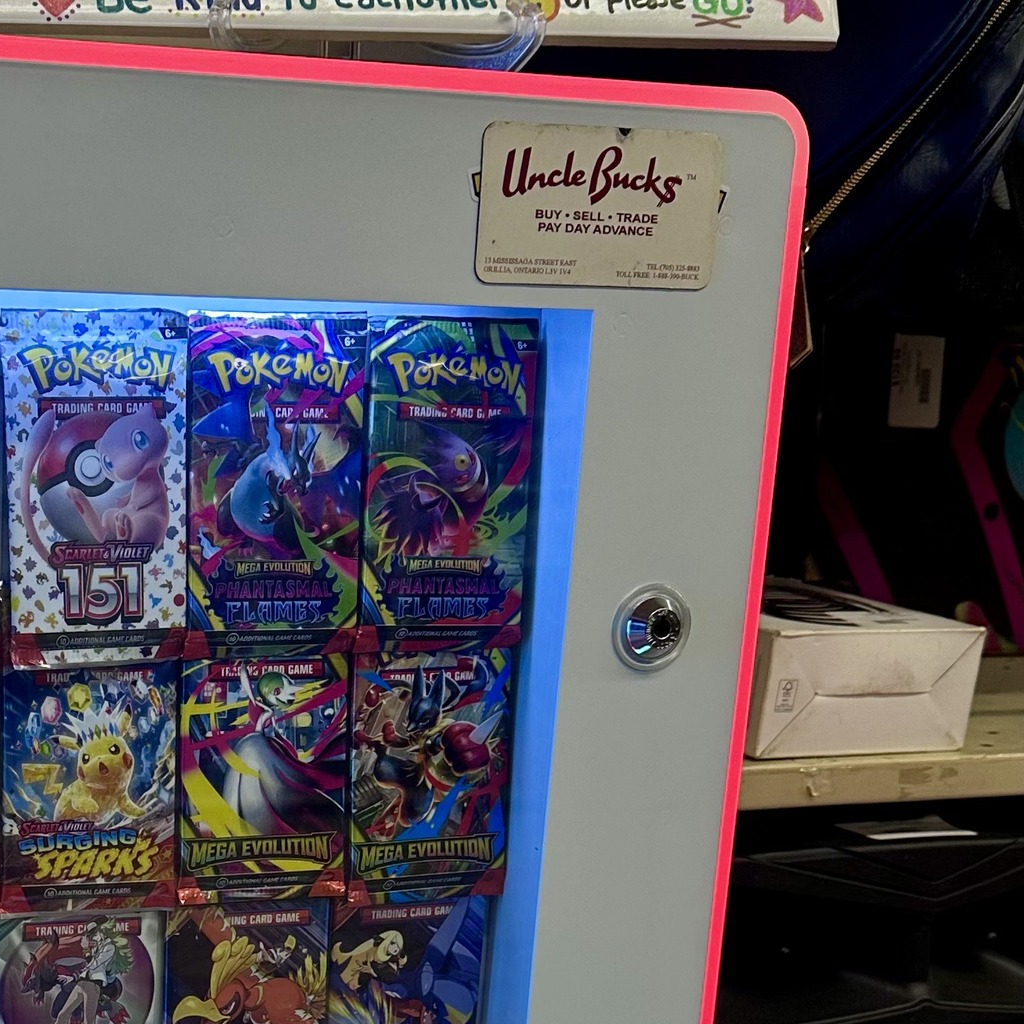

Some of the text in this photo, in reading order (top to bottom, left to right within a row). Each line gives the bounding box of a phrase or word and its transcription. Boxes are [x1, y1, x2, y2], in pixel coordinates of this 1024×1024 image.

[502, 147, 586, 198] Uncle
[535, 209, 658, 224] BUY SELL TRADE
[537, 222, 654, 237] PAY DAY ADVANCE
[534, 258, 559, 266] STREET
[560, 259, 577, 267] EAST
[164, 328, 176, 338] 6+
[344, 336, 356, 346] 6+
[517, 341, 527, 350] 6+
[52, 403, 123, 414] TRADING CARD
[53, 545, 151, 564] SCARLET VIOLET
[236, 561, 311, 575] MEGA EVOLUTION
[409, 559, 480, 573] MEGA EVOLUTION
[214, 579, 332, 599] PHANTASMAL
[387, 576, 500, 595] PHANTASMAL
[57, 562, 144, 626] 151
[225, 600, 322, 624] FLAMES
[397, 596, 489, 620] FLAMES
[288, 664, 313, 674] GAME
[63, 821, 93, 832] VIOLET
[19, 828, 137, 855] SURGING
[33, 837, 159, 880] SPARKS
[191, 835, 329, 867] MEGA EVOLUTION
[360, 837, 491, 871] MEGA EVOLUTION
[250, 914, 272, 925] CARD
[276, 912, 300, 923] GAME
[371, 909, 407, 920] TRADING
[410, 906, 431, 917] CARD
